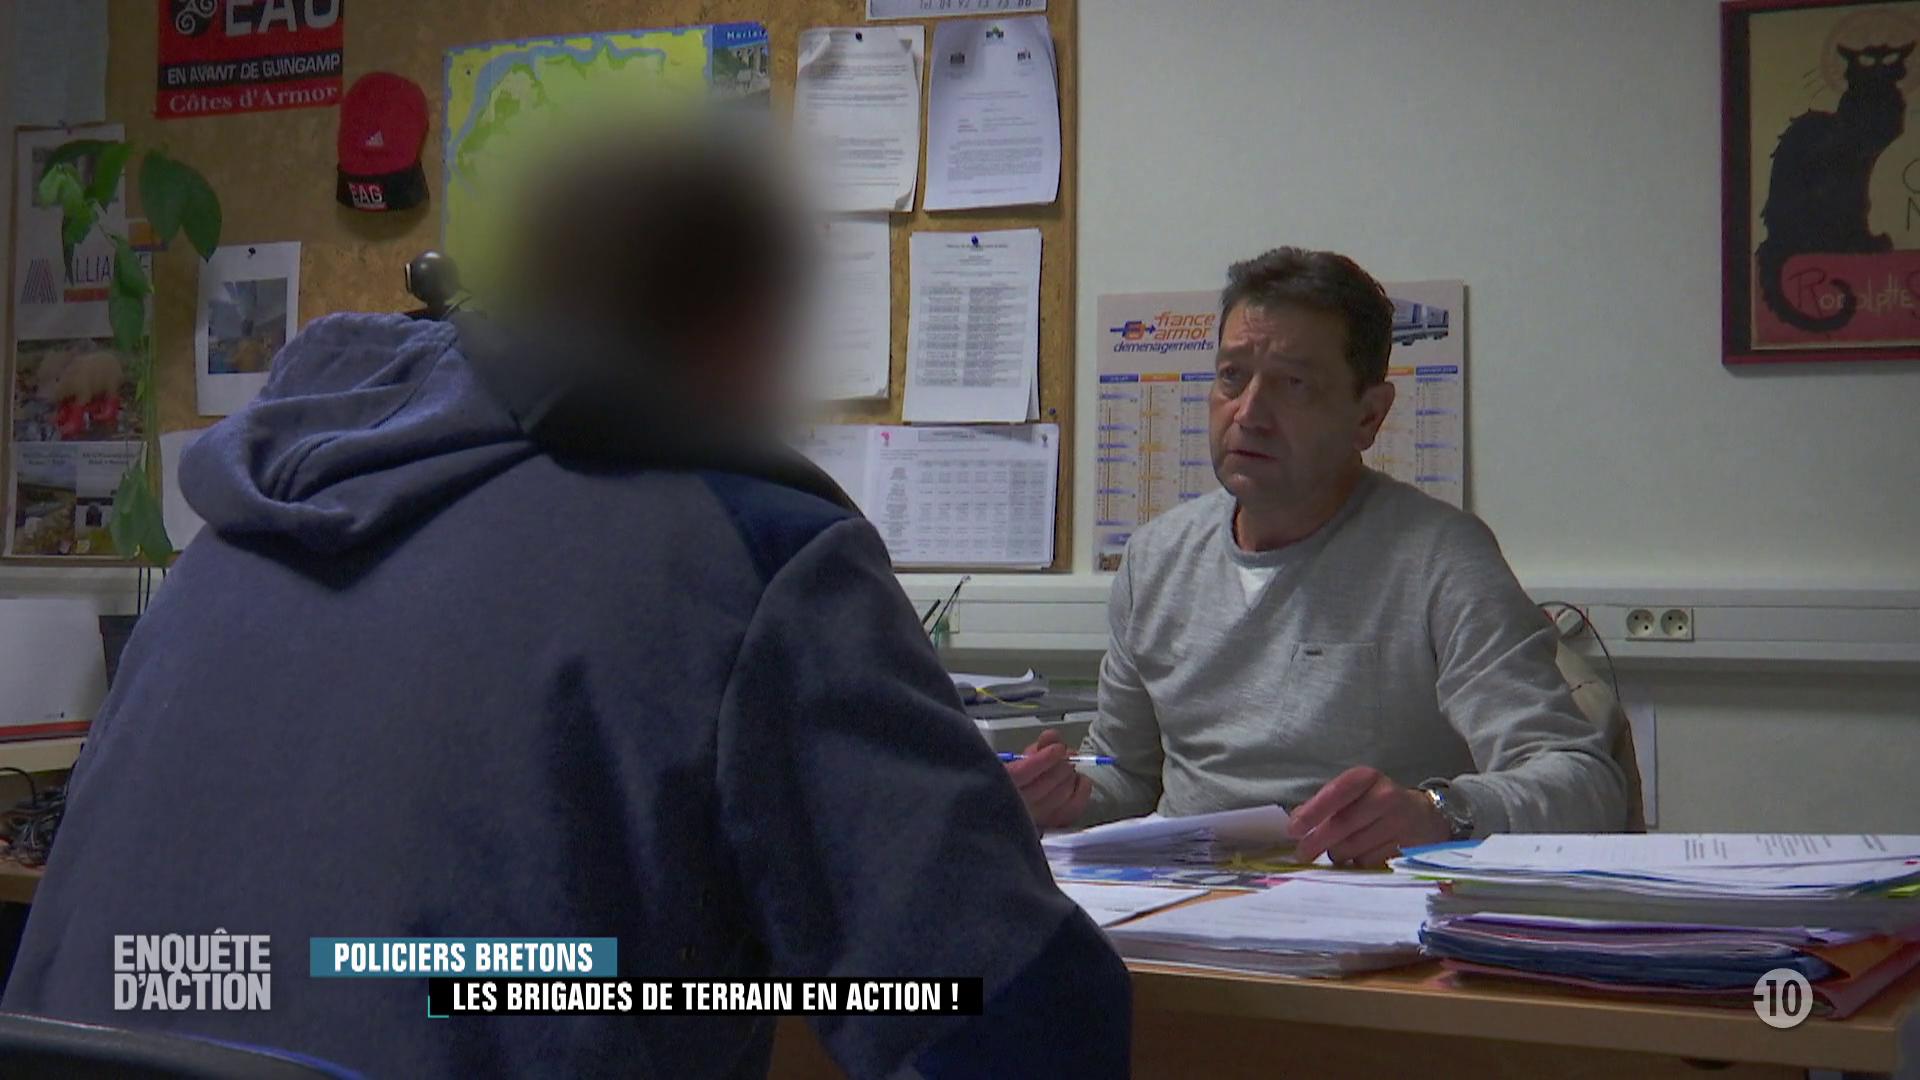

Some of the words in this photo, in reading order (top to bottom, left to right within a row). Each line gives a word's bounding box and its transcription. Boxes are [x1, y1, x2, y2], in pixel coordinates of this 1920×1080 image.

[168, 68, 187, 84] EN
[190, 65, 236, 82] AVANT
[241, 62, 259, 79] DE
[262, 53, 341, 77] GUINGAMP
[169, 92, 232, 113] Côtes
[239, 87, 338, 107] d'Armor
[349, 182, 383, 204] EAG
[1154, 311, 1216, 327] france
[1154, 328, 1211, 341] armor
